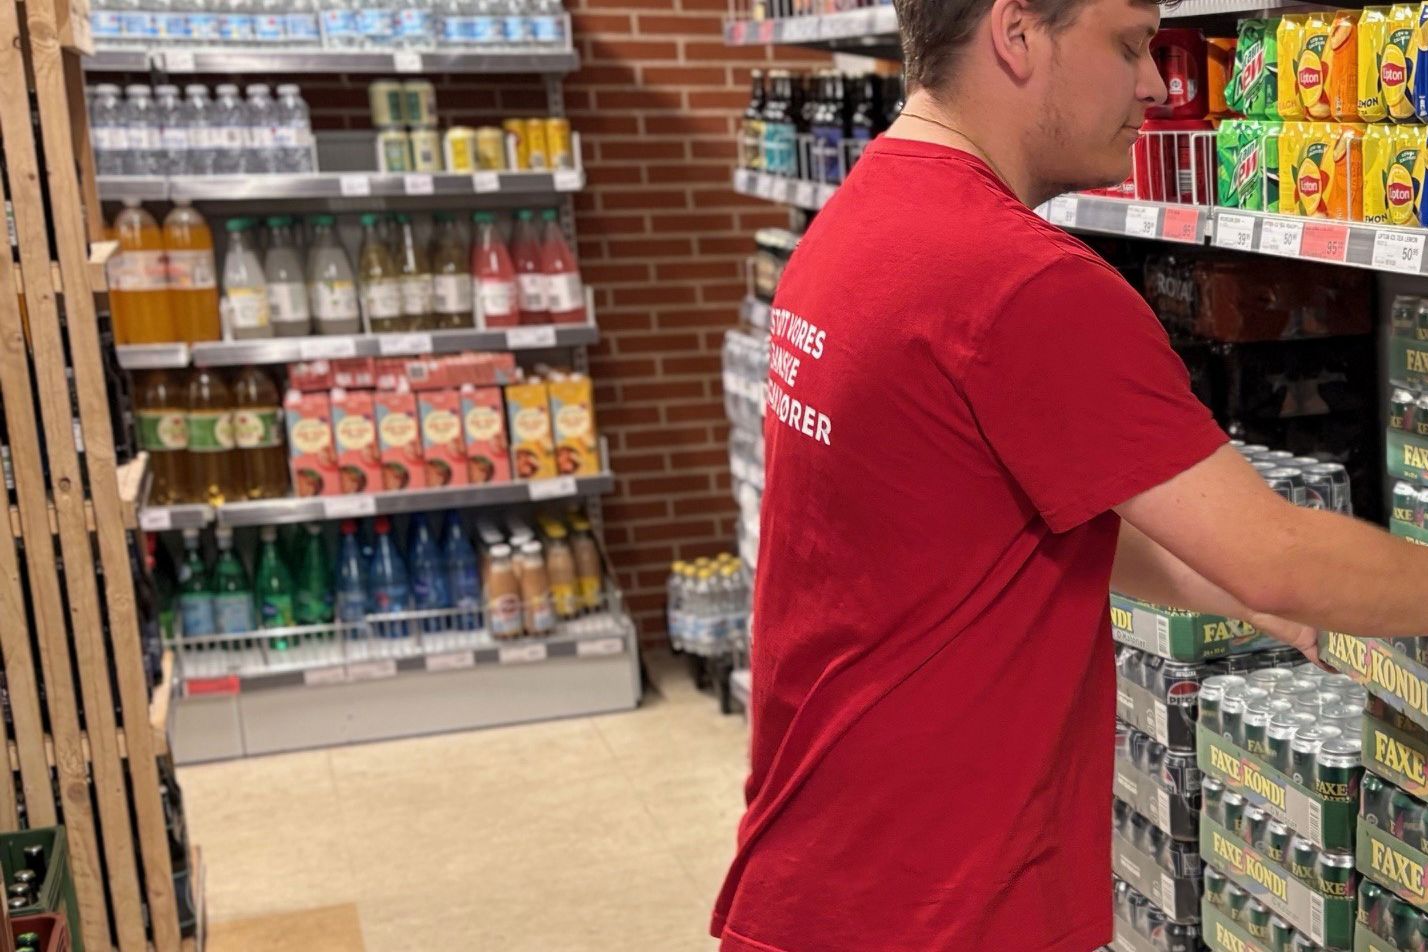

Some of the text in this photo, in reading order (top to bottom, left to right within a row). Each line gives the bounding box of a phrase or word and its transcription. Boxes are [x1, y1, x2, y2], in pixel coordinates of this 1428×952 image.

[1300, 72, 1319, 84] Lipton
[1383, 69, 1402, 82] Lipton
[1389, 188, 1410, 200] Lipton
[1402, 247, 1412, 260] 50
[1157, 272, 1194, 300] ROYAL
[787, 312, 826, 360] VORES
[1203, 620, 1256, 644] FAXE
[1328, 631, 1428, 717] FAXE KONDI
[1374, 730, 1426, 787] FAXE
[1210, 744, 1287, 813] FAXE KONDI
[1212, 831, 1287, 902] FAXE KONDI
[1371, 838, 1425, 896] FAXE
